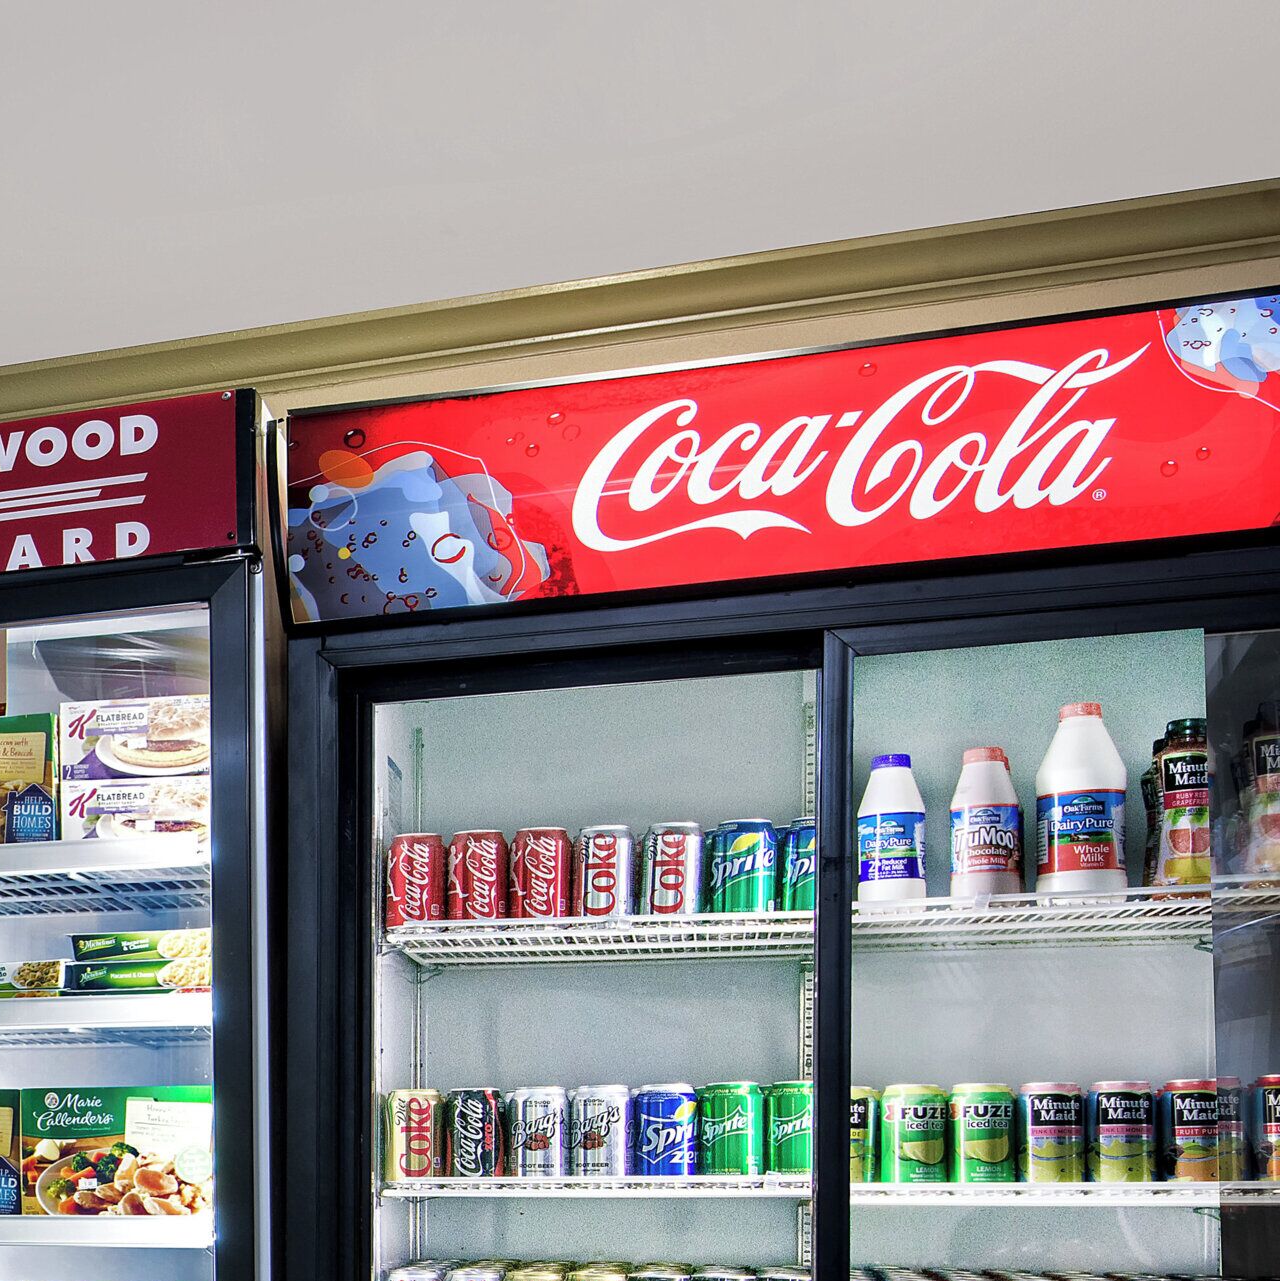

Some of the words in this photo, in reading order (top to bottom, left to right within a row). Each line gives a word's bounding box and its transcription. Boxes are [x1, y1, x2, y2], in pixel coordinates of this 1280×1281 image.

[571, 341, 1151, 553] Coca-Cola
[69, 709, 97, 740] K
[96, 712, 145, 723] FLATBREAD
[24, 796, 43, 804] HELP
[69, 788, 97, 818] K
[96, 792, 146, 802] FLATBREAD
[13, 805, 52, 816] BUILD
[12, 816, 51, 829] HOMES
[1073, 844, 1110, 854] Whole
[1081, 853, 1104, 862] Milk
[652, 831, 686, 915] Coke
[709, 847, 775, 888] Sprite
[399, 842, 429, 921] Coca-Cola
[467, 836, 497, 919] Coca-Cola
[528, 834, 555, 918] Coca-Cola
[584, 834, 616, 917] Coke
[58, 1095, 103, 1115] Marie
[1033, 1097, 1080, 1110] Minute
[1101, 1096, 1149, 1109] Minute
[901, 1105, 945, 1119] FUZE
[963, 1104, 1012, 1118] FUZE
[1040, 1109, 1075, 1121] Maid
[1107, 1108, 1145, 1120] Maid
[33, 1111, 113, 1131] Callender's
[571, 1106, 620, 1149] Barq's
[907, 1120, 928, 1129] iced
[967, 1119, 990, 1128] iced
[992, 1120, 1008, 1128] tea
[703, 1117, 752, 1142] Sprite
[399, 1097, 431, 1177] Coke
